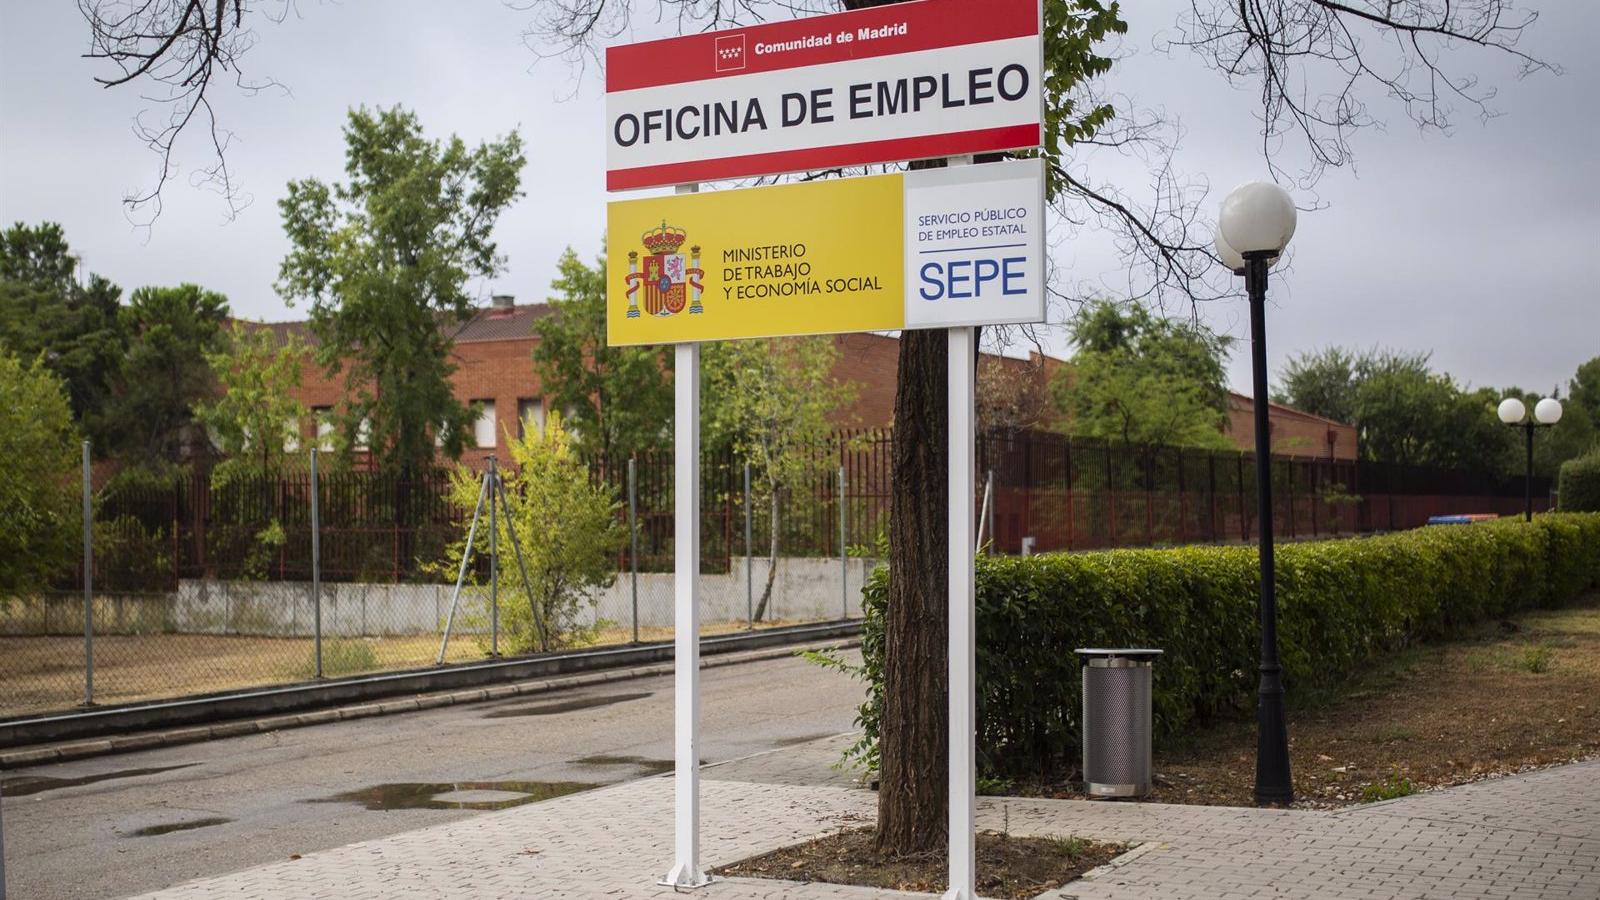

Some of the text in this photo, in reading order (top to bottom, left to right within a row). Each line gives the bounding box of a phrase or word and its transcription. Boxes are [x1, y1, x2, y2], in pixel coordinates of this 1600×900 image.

[754, 23, 907, 55] Comunidad de Madrid
[614, 63, 1030, 148] OFICINA DE EMPLEO
[918, 207, 1027, 227] SERVICIO PÚBLICO
[918, 223, 1027, 242] DE EMPLEO ESTATAL
[723, 243, 806, 263] MINISTERIO
[723, 262, 811, 282] DE TRABAJO
[919, 256, 1027, 301] SEPE
[723, 276, 883, 300] Y ECONOMÍA SOCIAL
